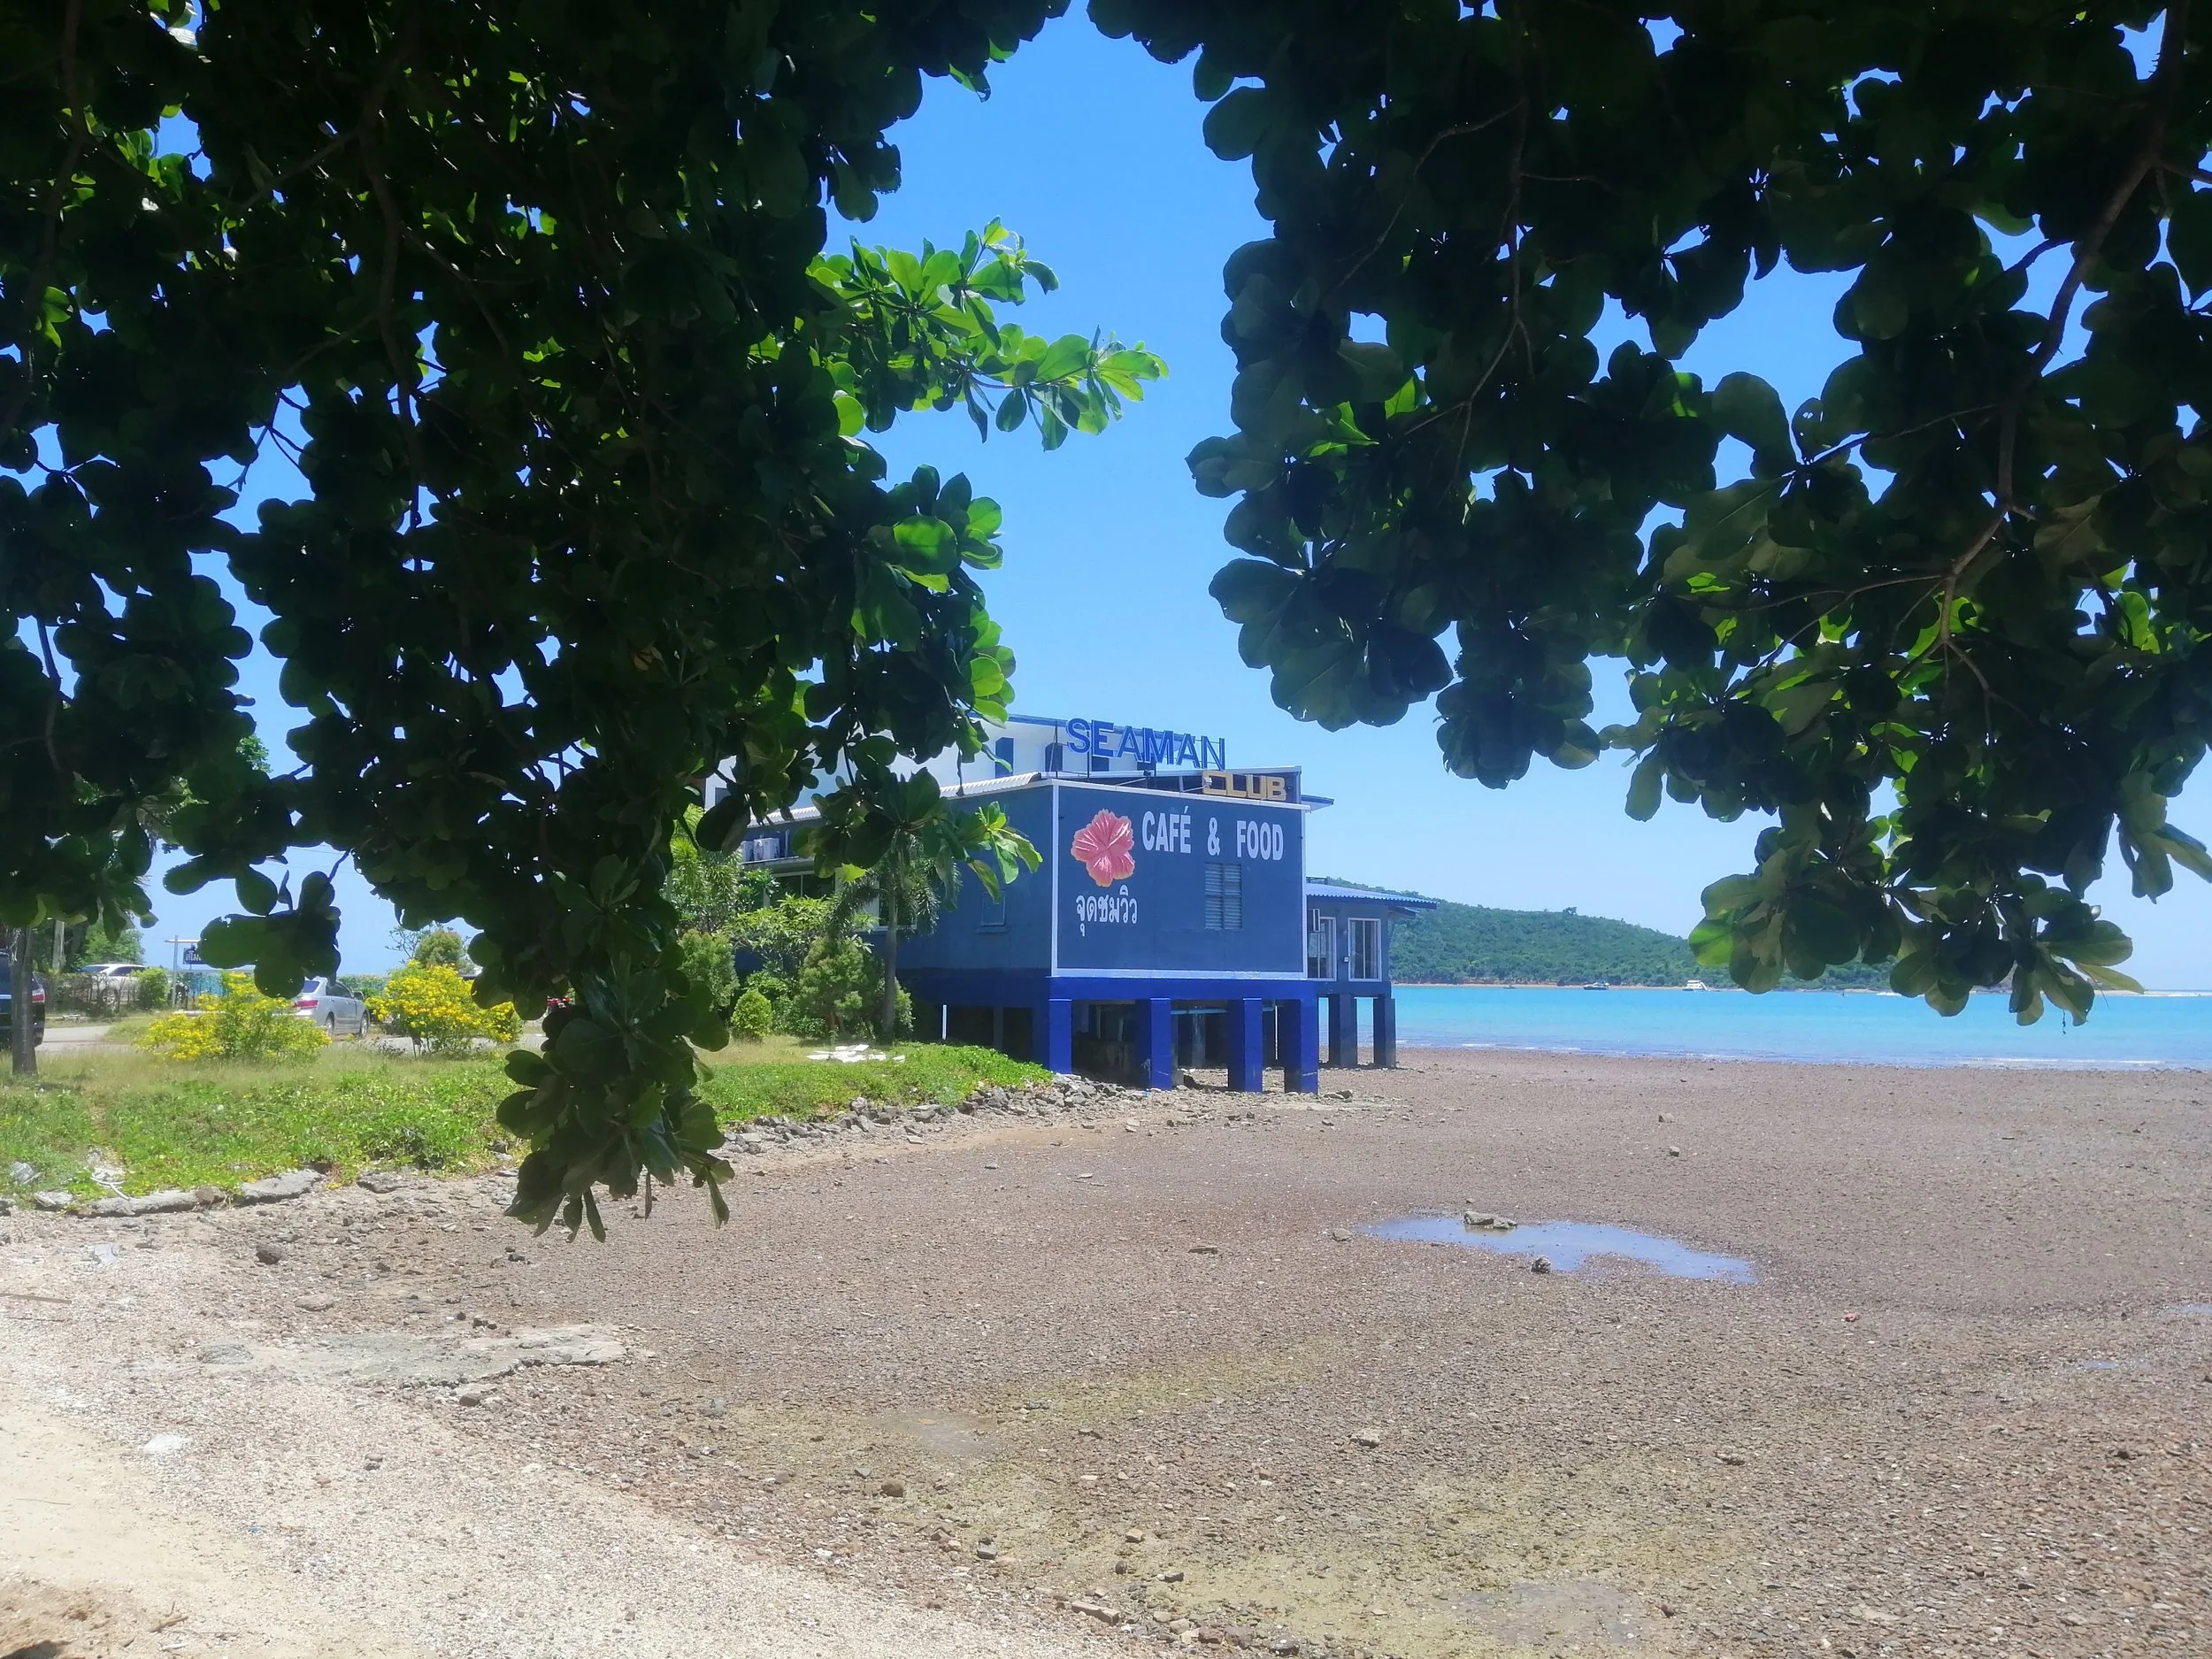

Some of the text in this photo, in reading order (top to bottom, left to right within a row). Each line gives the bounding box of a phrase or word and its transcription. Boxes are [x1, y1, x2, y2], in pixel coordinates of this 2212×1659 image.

[1065, 718, 1225, 771] SEAMAN
[1202, 771, 1286, 801] CLUB
[1141, 806, 1284, 861] CAFÉ & FOOD
[1076, 885, 1138, 937] จุดชมวิว
